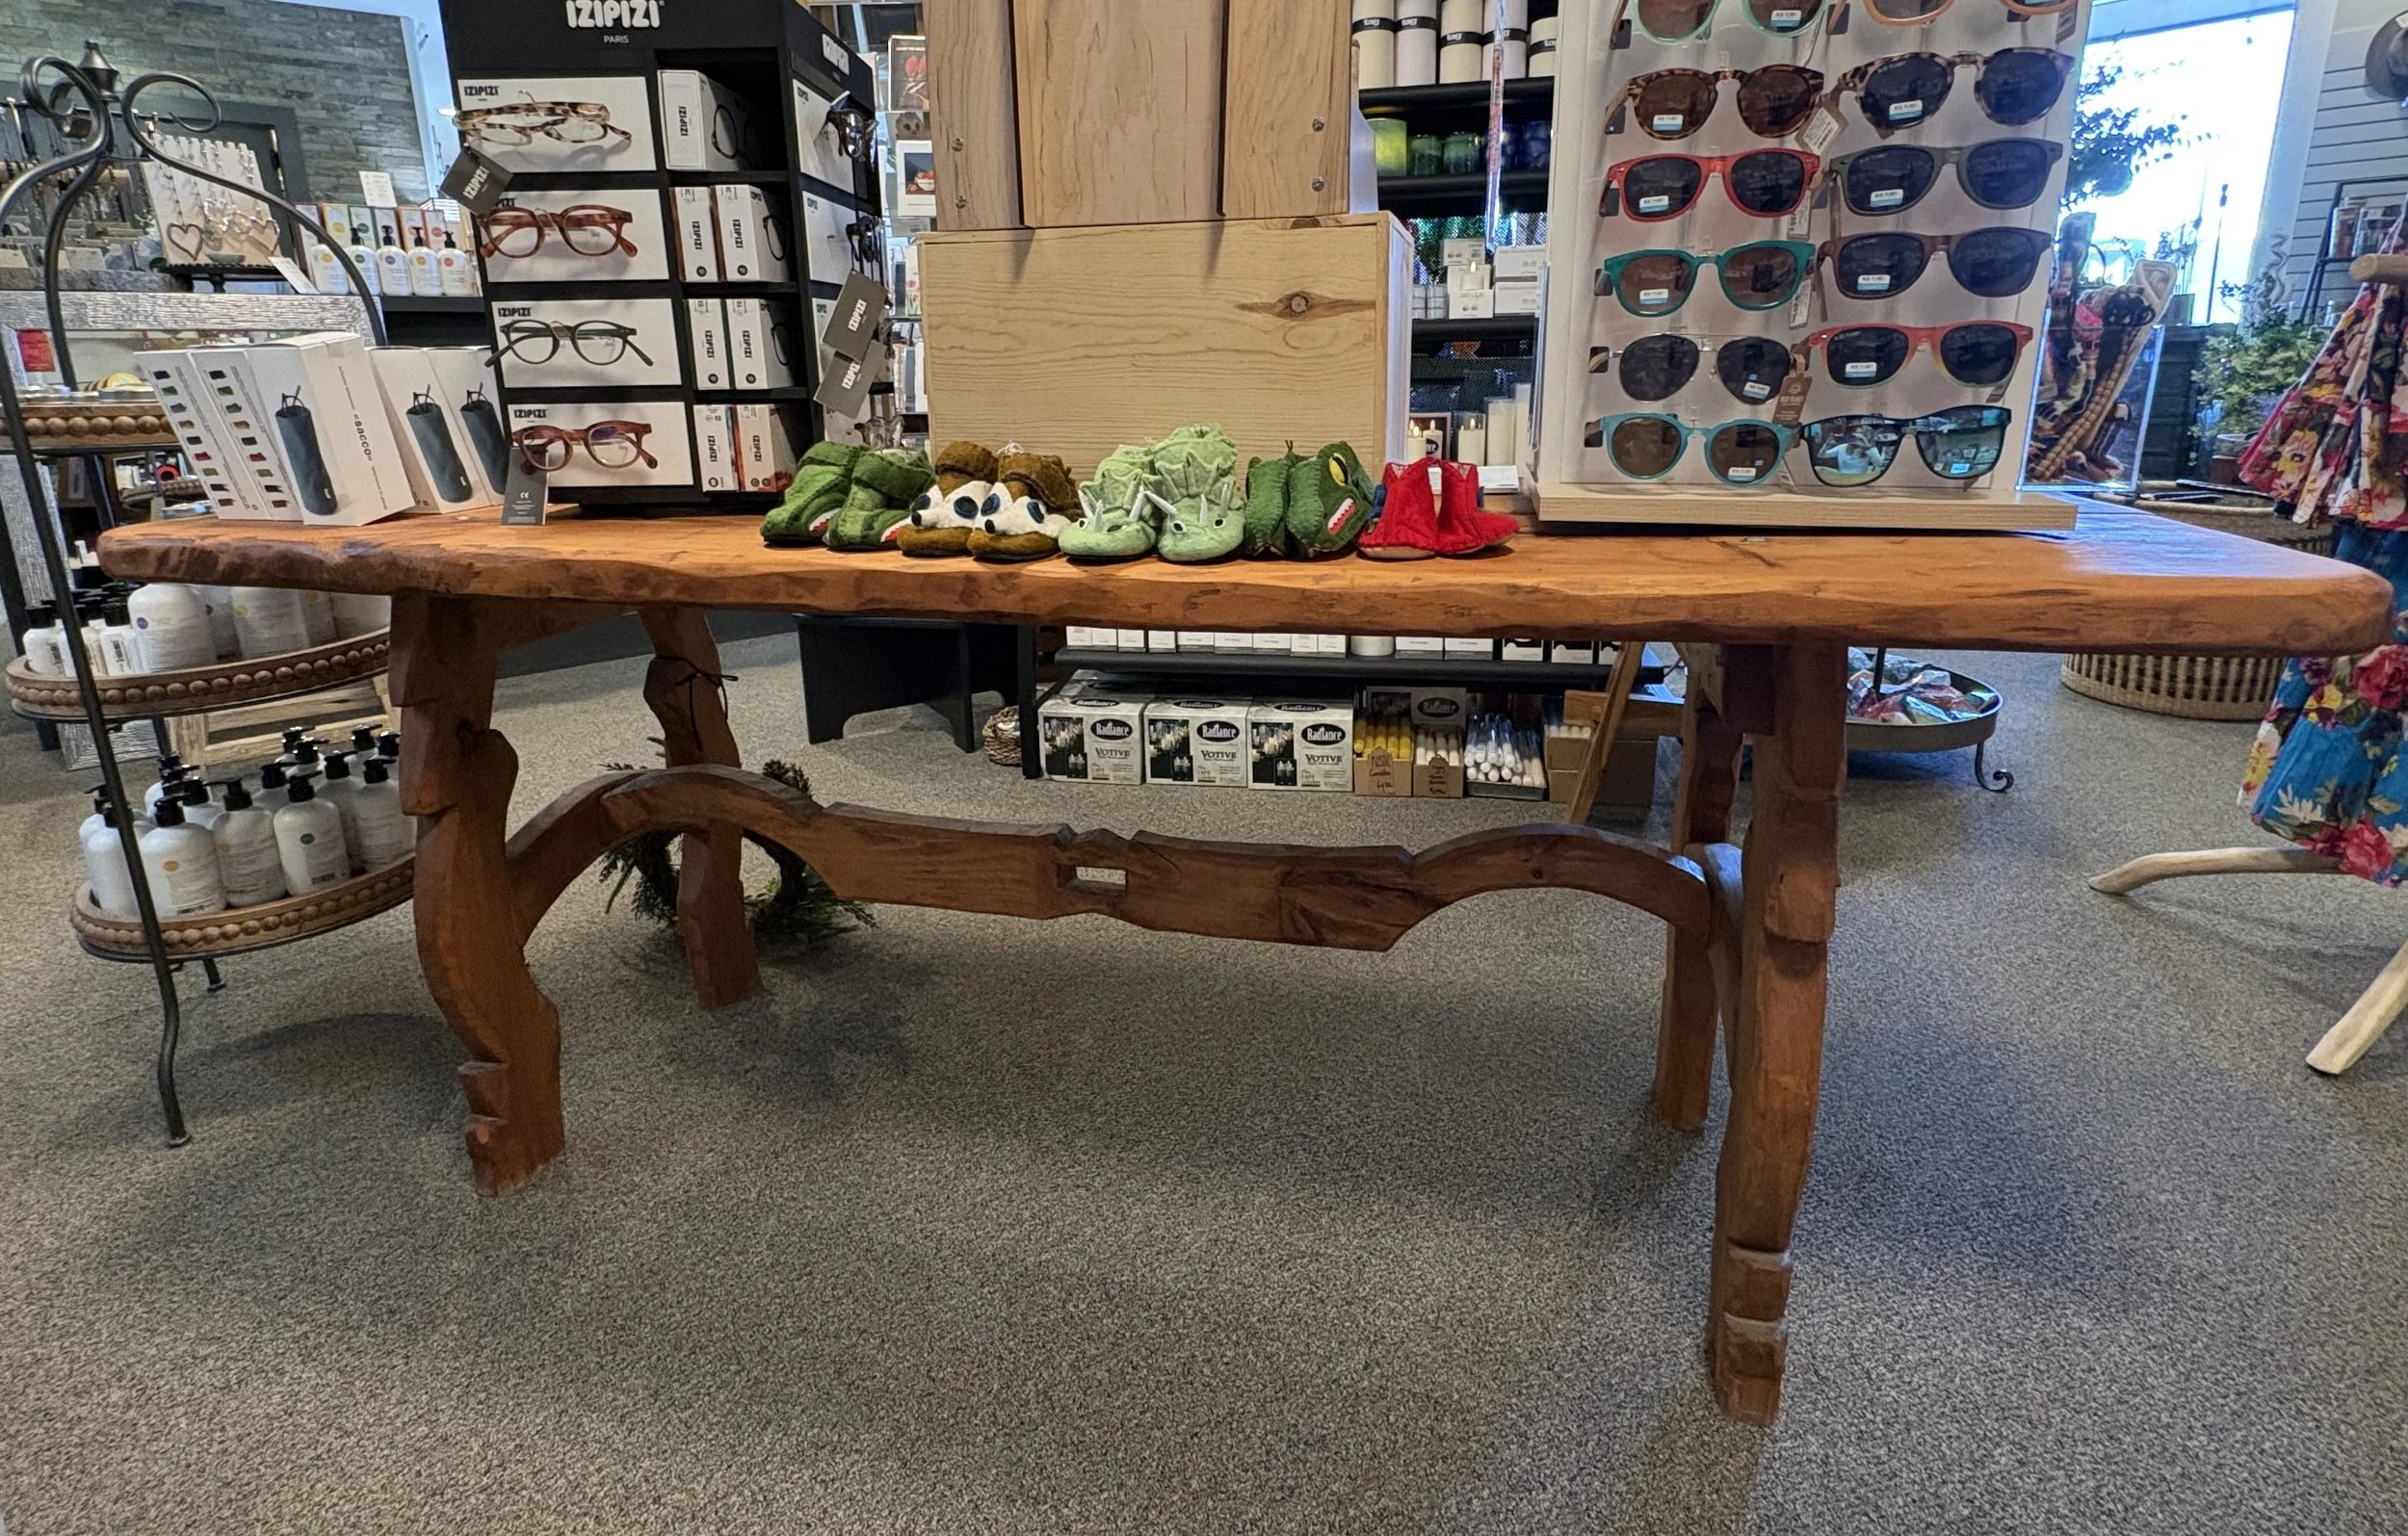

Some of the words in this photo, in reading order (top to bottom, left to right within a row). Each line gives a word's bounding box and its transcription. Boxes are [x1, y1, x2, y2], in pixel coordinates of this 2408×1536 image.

[566, 0, 661, 28] IZIPIZI
[1401, 17, 1418, 27] tag
[1364, 18, 1380, 27] tag
[603, 35, 629, 43] PARIS
[1447, 32, 1462, 41] tag
[464, 86, 499, 96] IZIPIZI
[678, 106, 689, 137] IZIPIZI
[463, 165, 489, 199] IZIPIZI
[692, 221, 703, 249] IZIPIZI
[732, 219, 744, 248] IZIPIZI
[498, 307, 531, 317] IZIPIZI
[848, 299, 867, 331] IZIPIZI
[705, 330, 715, 359] IZIPIZI
[743, 330, 752, 359] IZIPIZI
[841, 360, 861, 389] IZIPIZ
[513, 409, 546, 418] IZIPIZI
[707, 435, 718, 462] IZIPIZI
[752, 434, 762, 462] IZIPIZI
[1096, 721, 1130, 737] Radiance
[1202, 723, 1237, 739] Radiance
[1306, 726, 1343, 742] Radiance
[1095, 747, 1131, 758] VOTIVE
[1200, 749, 1237, 760] VOTIVE
[1305, 754, 1343, 764] VOTIVE
